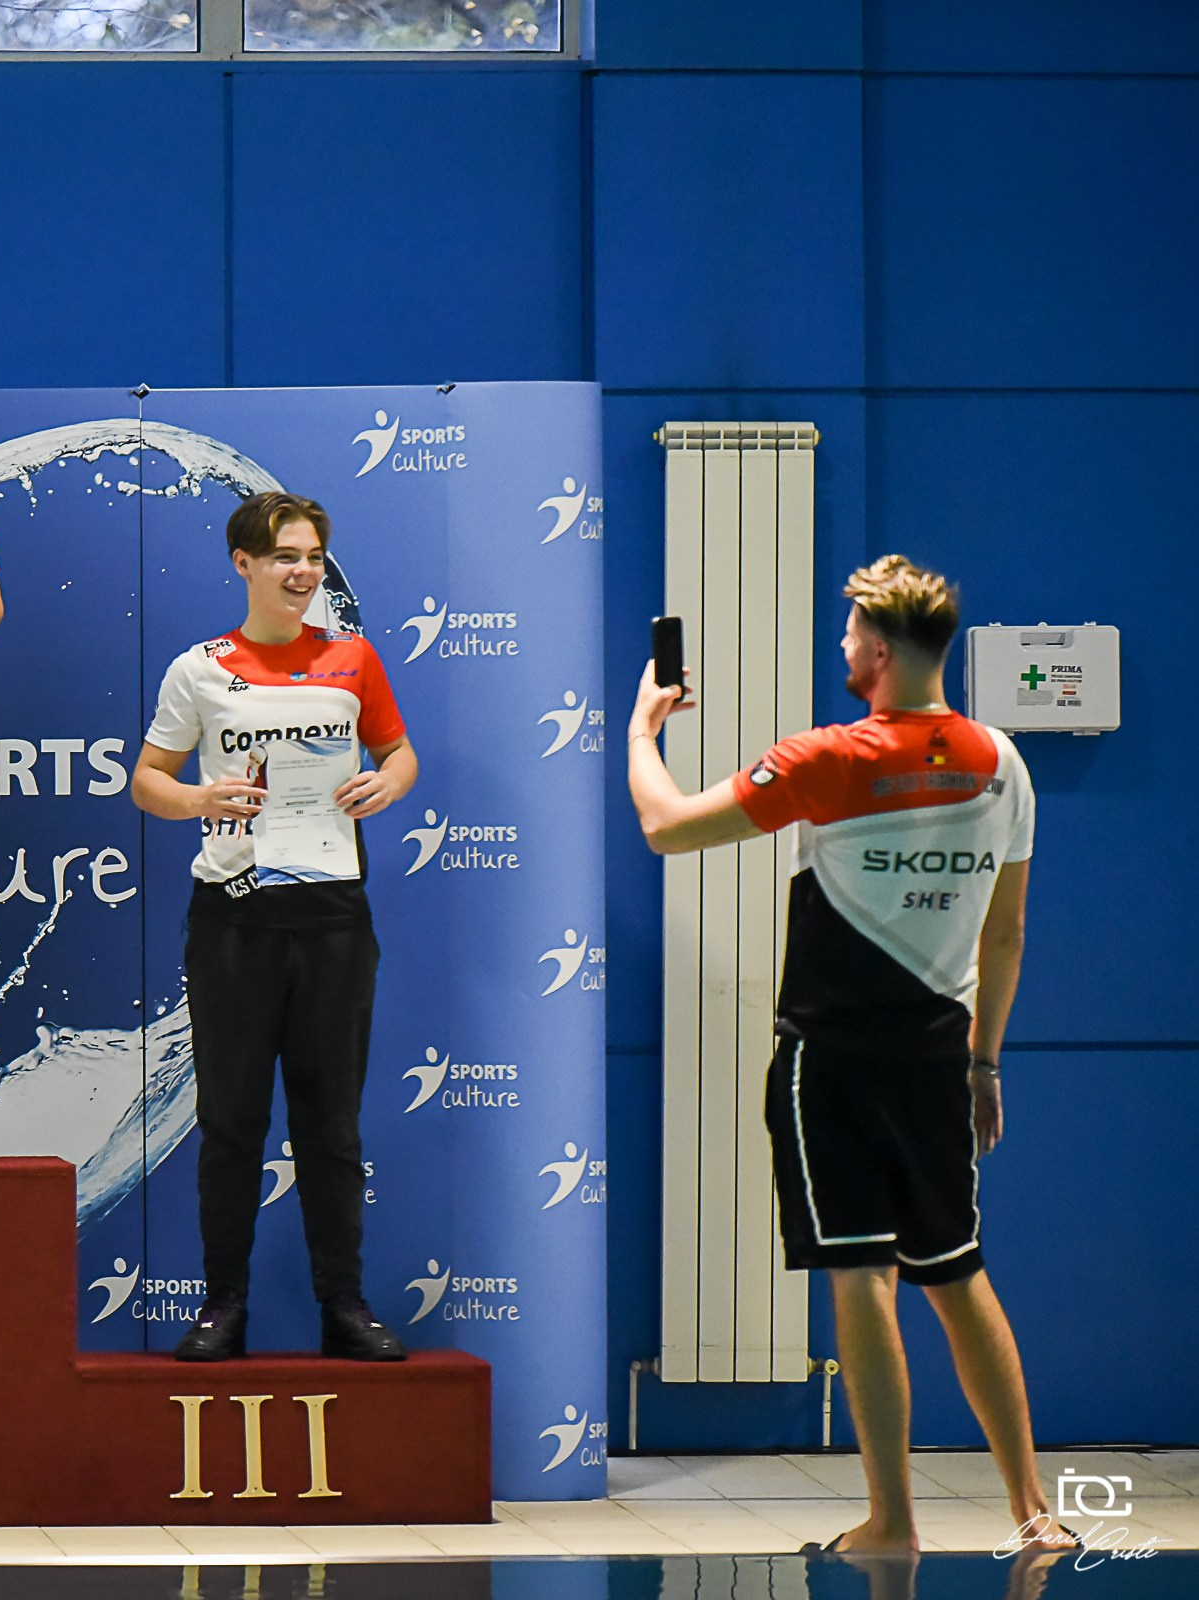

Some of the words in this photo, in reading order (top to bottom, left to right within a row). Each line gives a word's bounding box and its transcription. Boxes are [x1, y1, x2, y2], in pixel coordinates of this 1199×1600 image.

[401, 425, 466, 445] SPORTS
[392, 448, 468, 472] Culture
[448, 612, 517, 629] SPORTS
[439, 634, 520, 658] Culture
[1051, 665, 1082, 674] PRIMA
[228, 684, 251, 693] PEAK
[449, 826, 518, 842] SPORTS
[441, 846, 520, 870] Culture
[450, 1064, 518, 1081] SPORTS
[442, 1084, 521, 1108] Culture
[451, 1276, 518, 1294] SPORTS
[132, 1299, 203, 1321] Cultur
[443, 1297, 521, 1321] Culture
[169, 1393, 343, 1498] III
